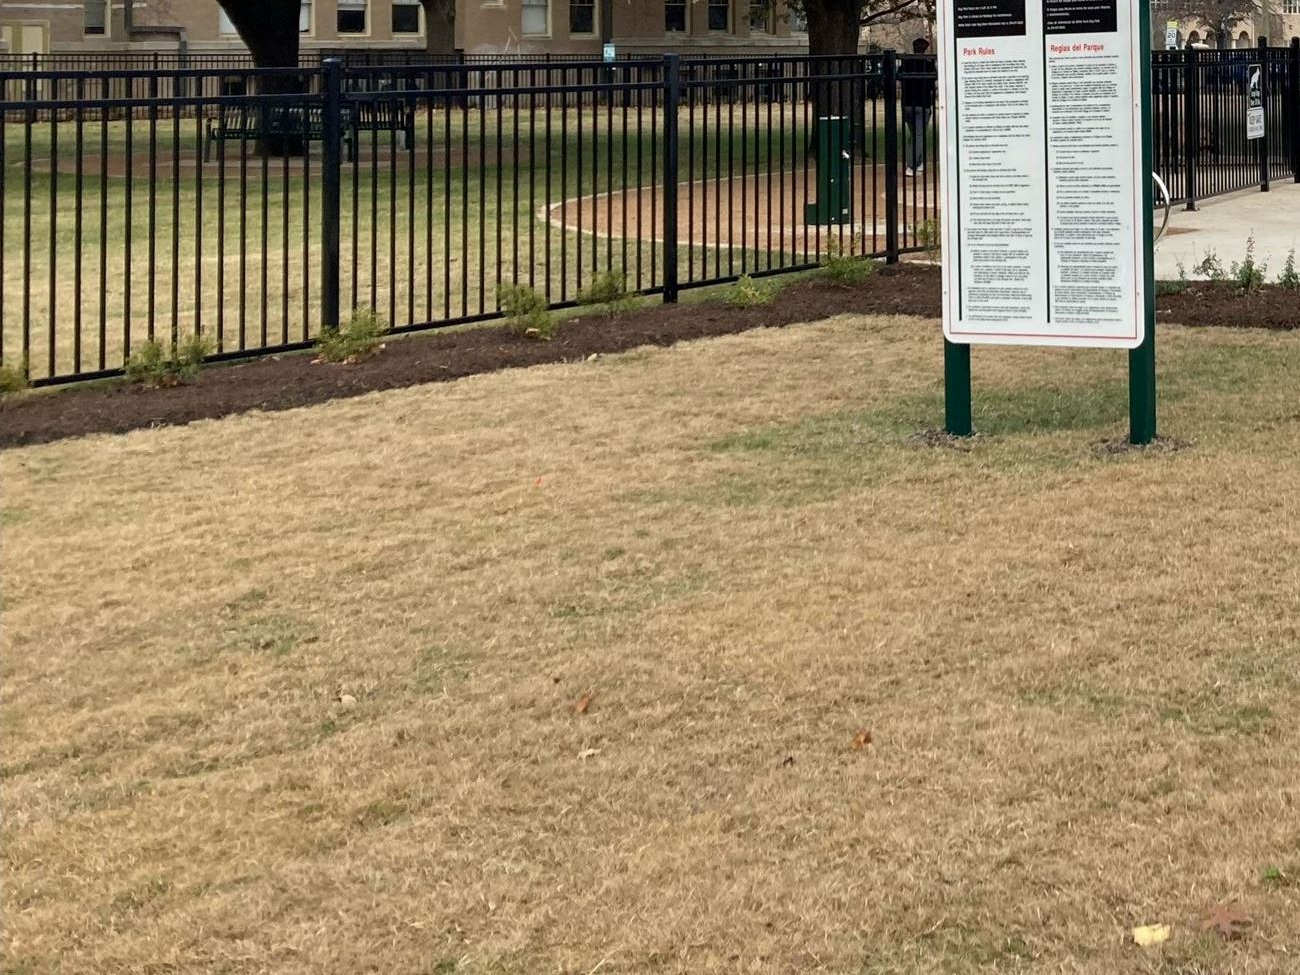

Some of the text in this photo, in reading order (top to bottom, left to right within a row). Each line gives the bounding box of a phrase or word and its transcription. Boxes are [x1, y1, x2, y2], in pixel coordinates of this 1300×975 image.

[963, 47, 995, 56] Park Rules
[1051, 43, 1104, 53] Reglas del Parque
